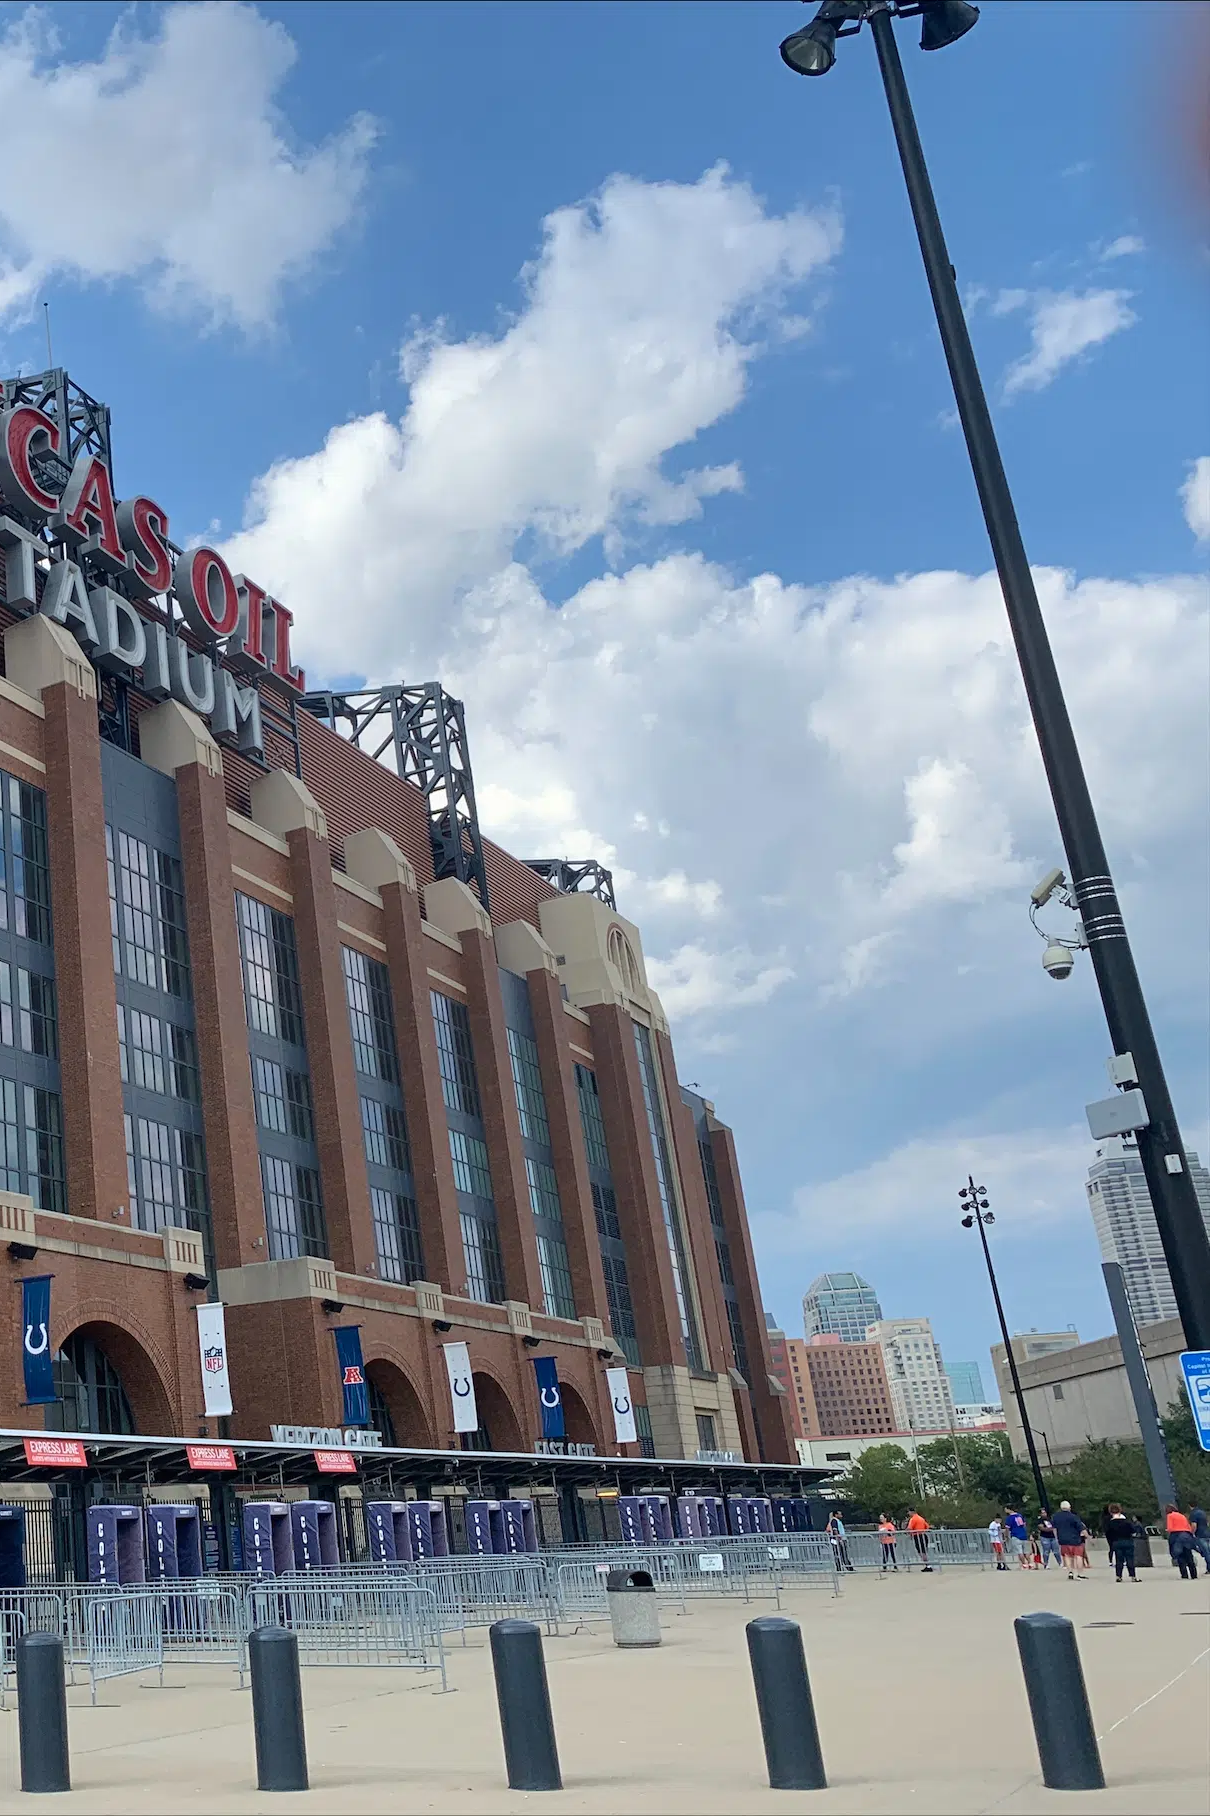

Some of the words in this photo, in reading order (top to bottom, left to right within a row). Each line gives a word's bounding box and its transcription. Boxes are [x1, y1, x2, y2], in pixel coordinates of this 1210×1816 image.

[176, 545, 305, 698] OIL
[206, 1356, 223, 1371] NFL
[270, 1425, 343, 1446] VERIZON
[344, 1429, 383, 1448] GATE
[30, 1441, 61, 1454] EXPRESS
[62, 1443, 80, 1455] LANE
[191, 1447, 215, 1459] EXPRESS
[216, 1449, 231, 1460] LANE
[534, 1441, 564, 1456] EAST
[567, 1442, 595, 1457] GATE
[318, 1452, 338, 1463] EXPRESS
